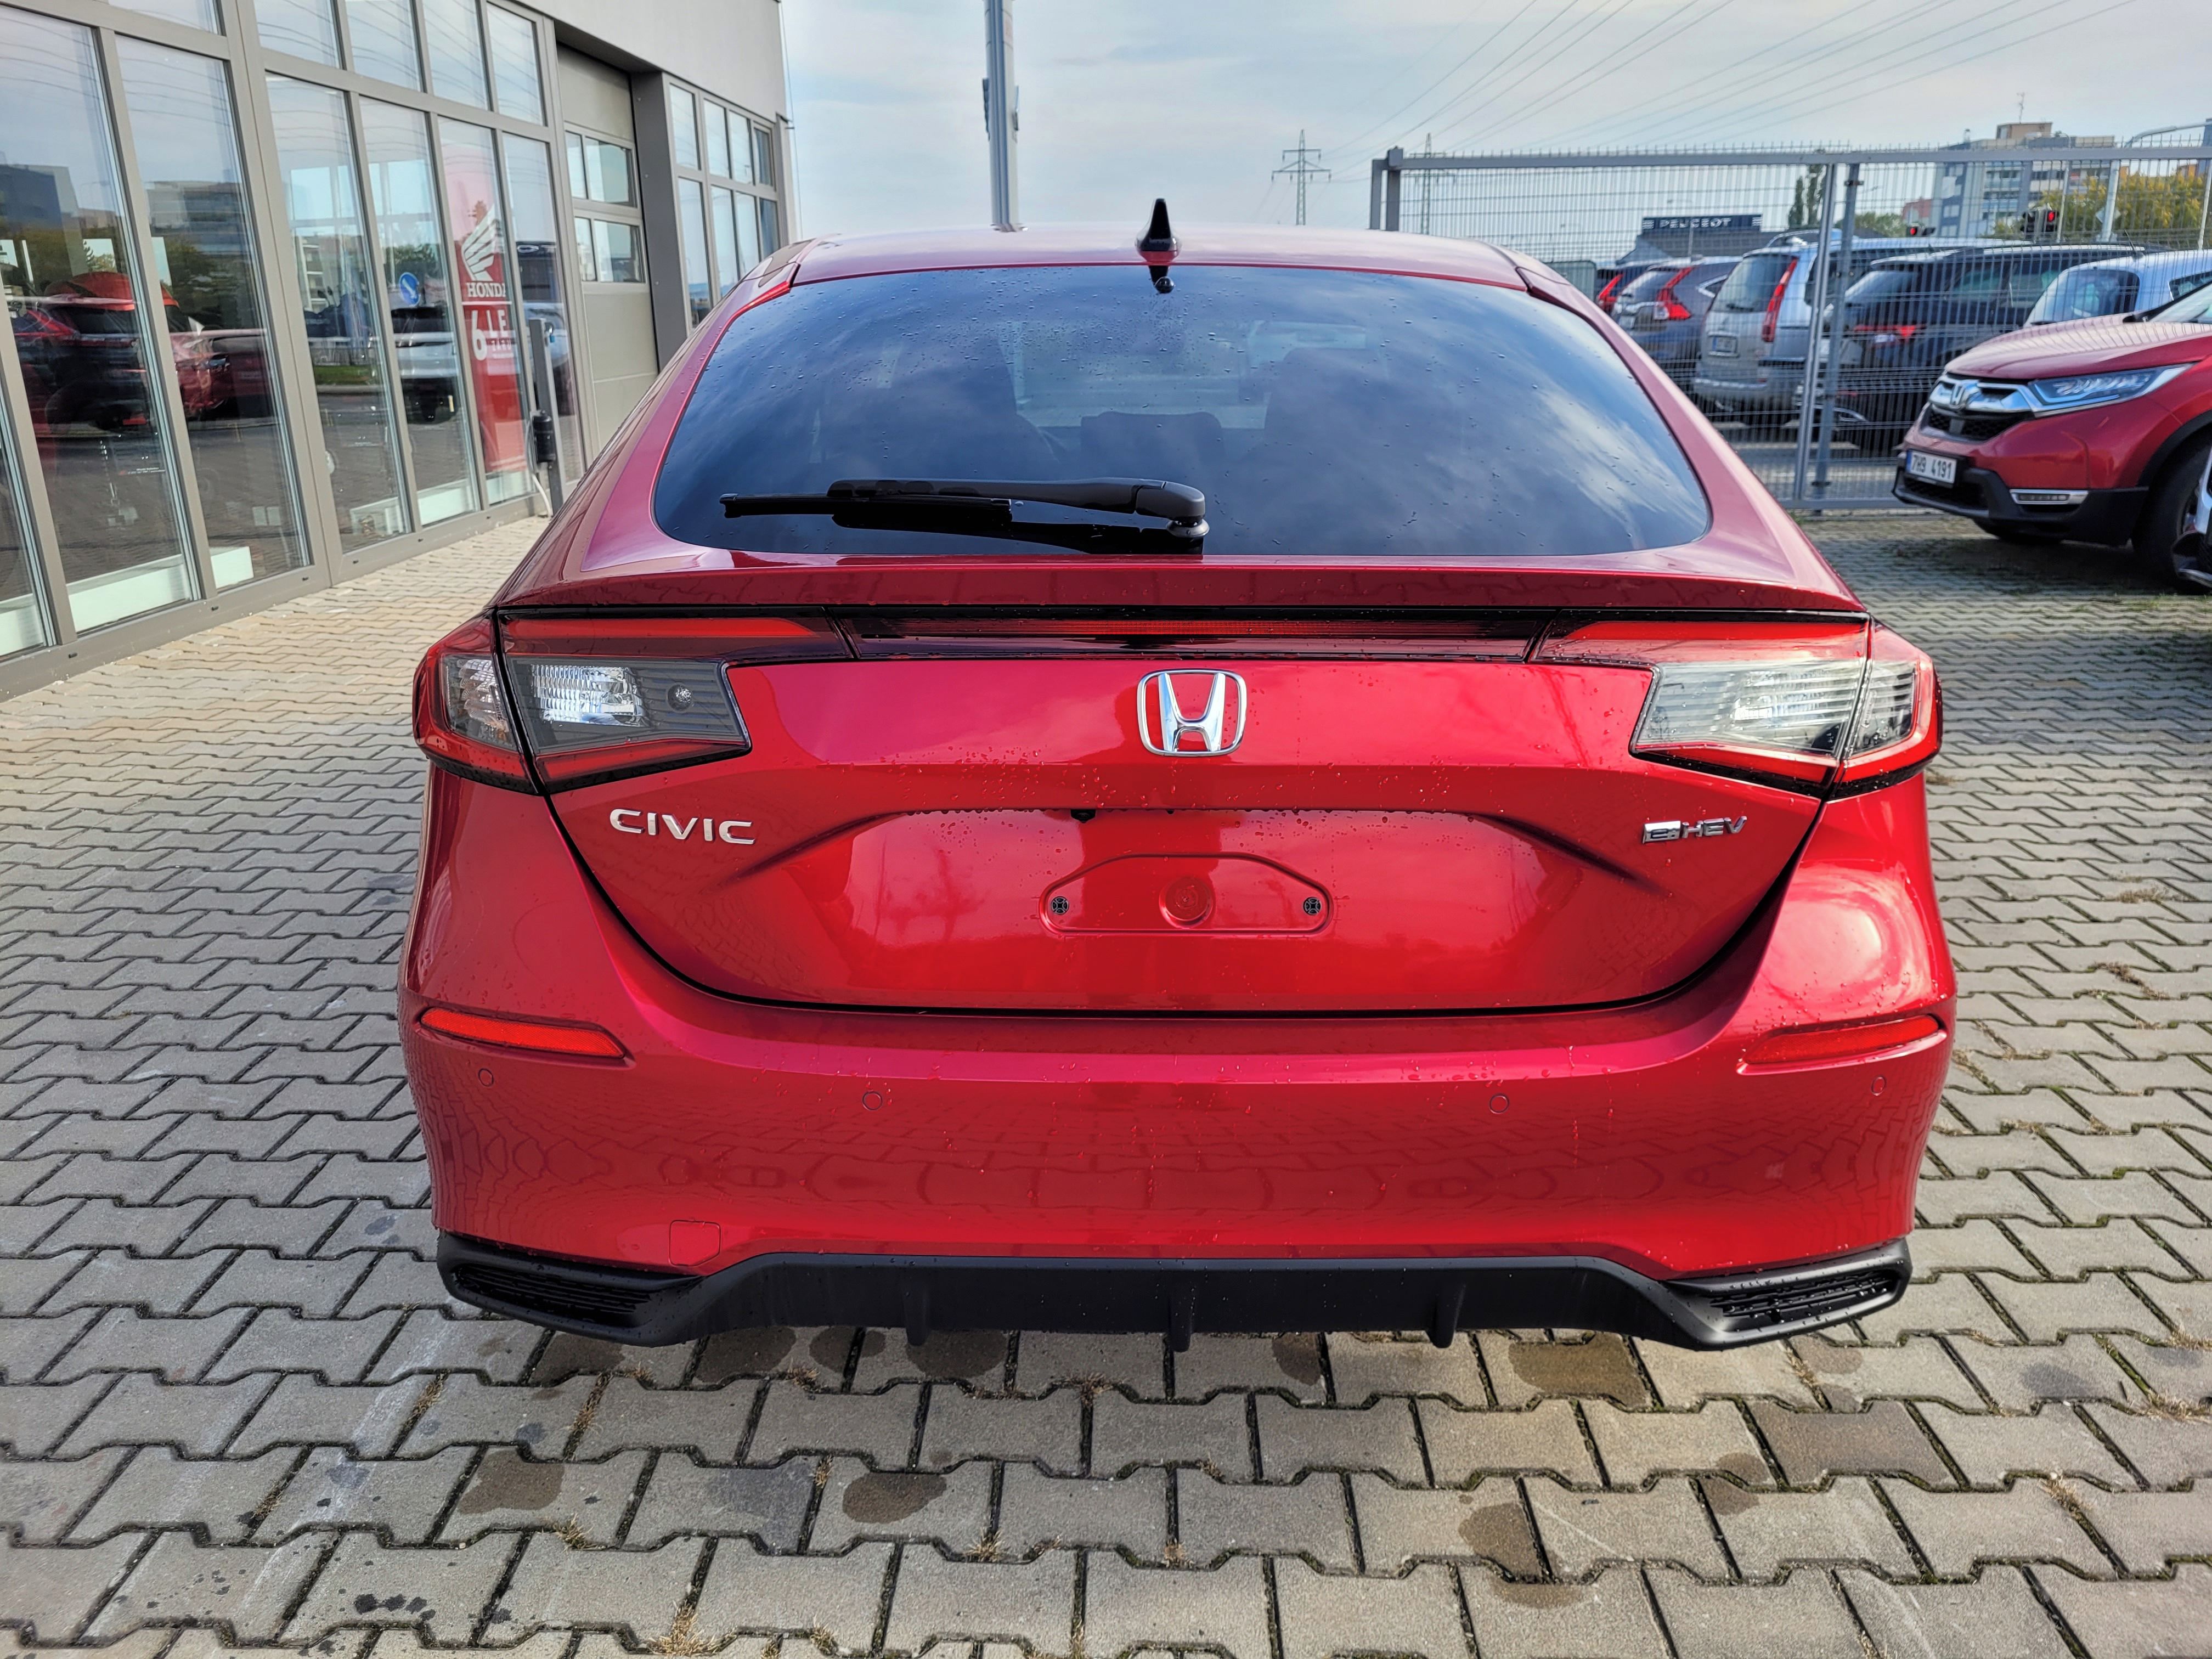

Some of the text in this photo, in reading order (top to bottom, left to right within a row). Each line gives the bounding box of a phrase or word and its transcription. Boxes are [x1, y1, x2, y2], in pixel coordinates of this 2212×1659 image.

[1660, 218, 1732, 229] PEUGEOT
[471, 309, 488, 361] 6
[610, 809, 756, 845] CIVIC
